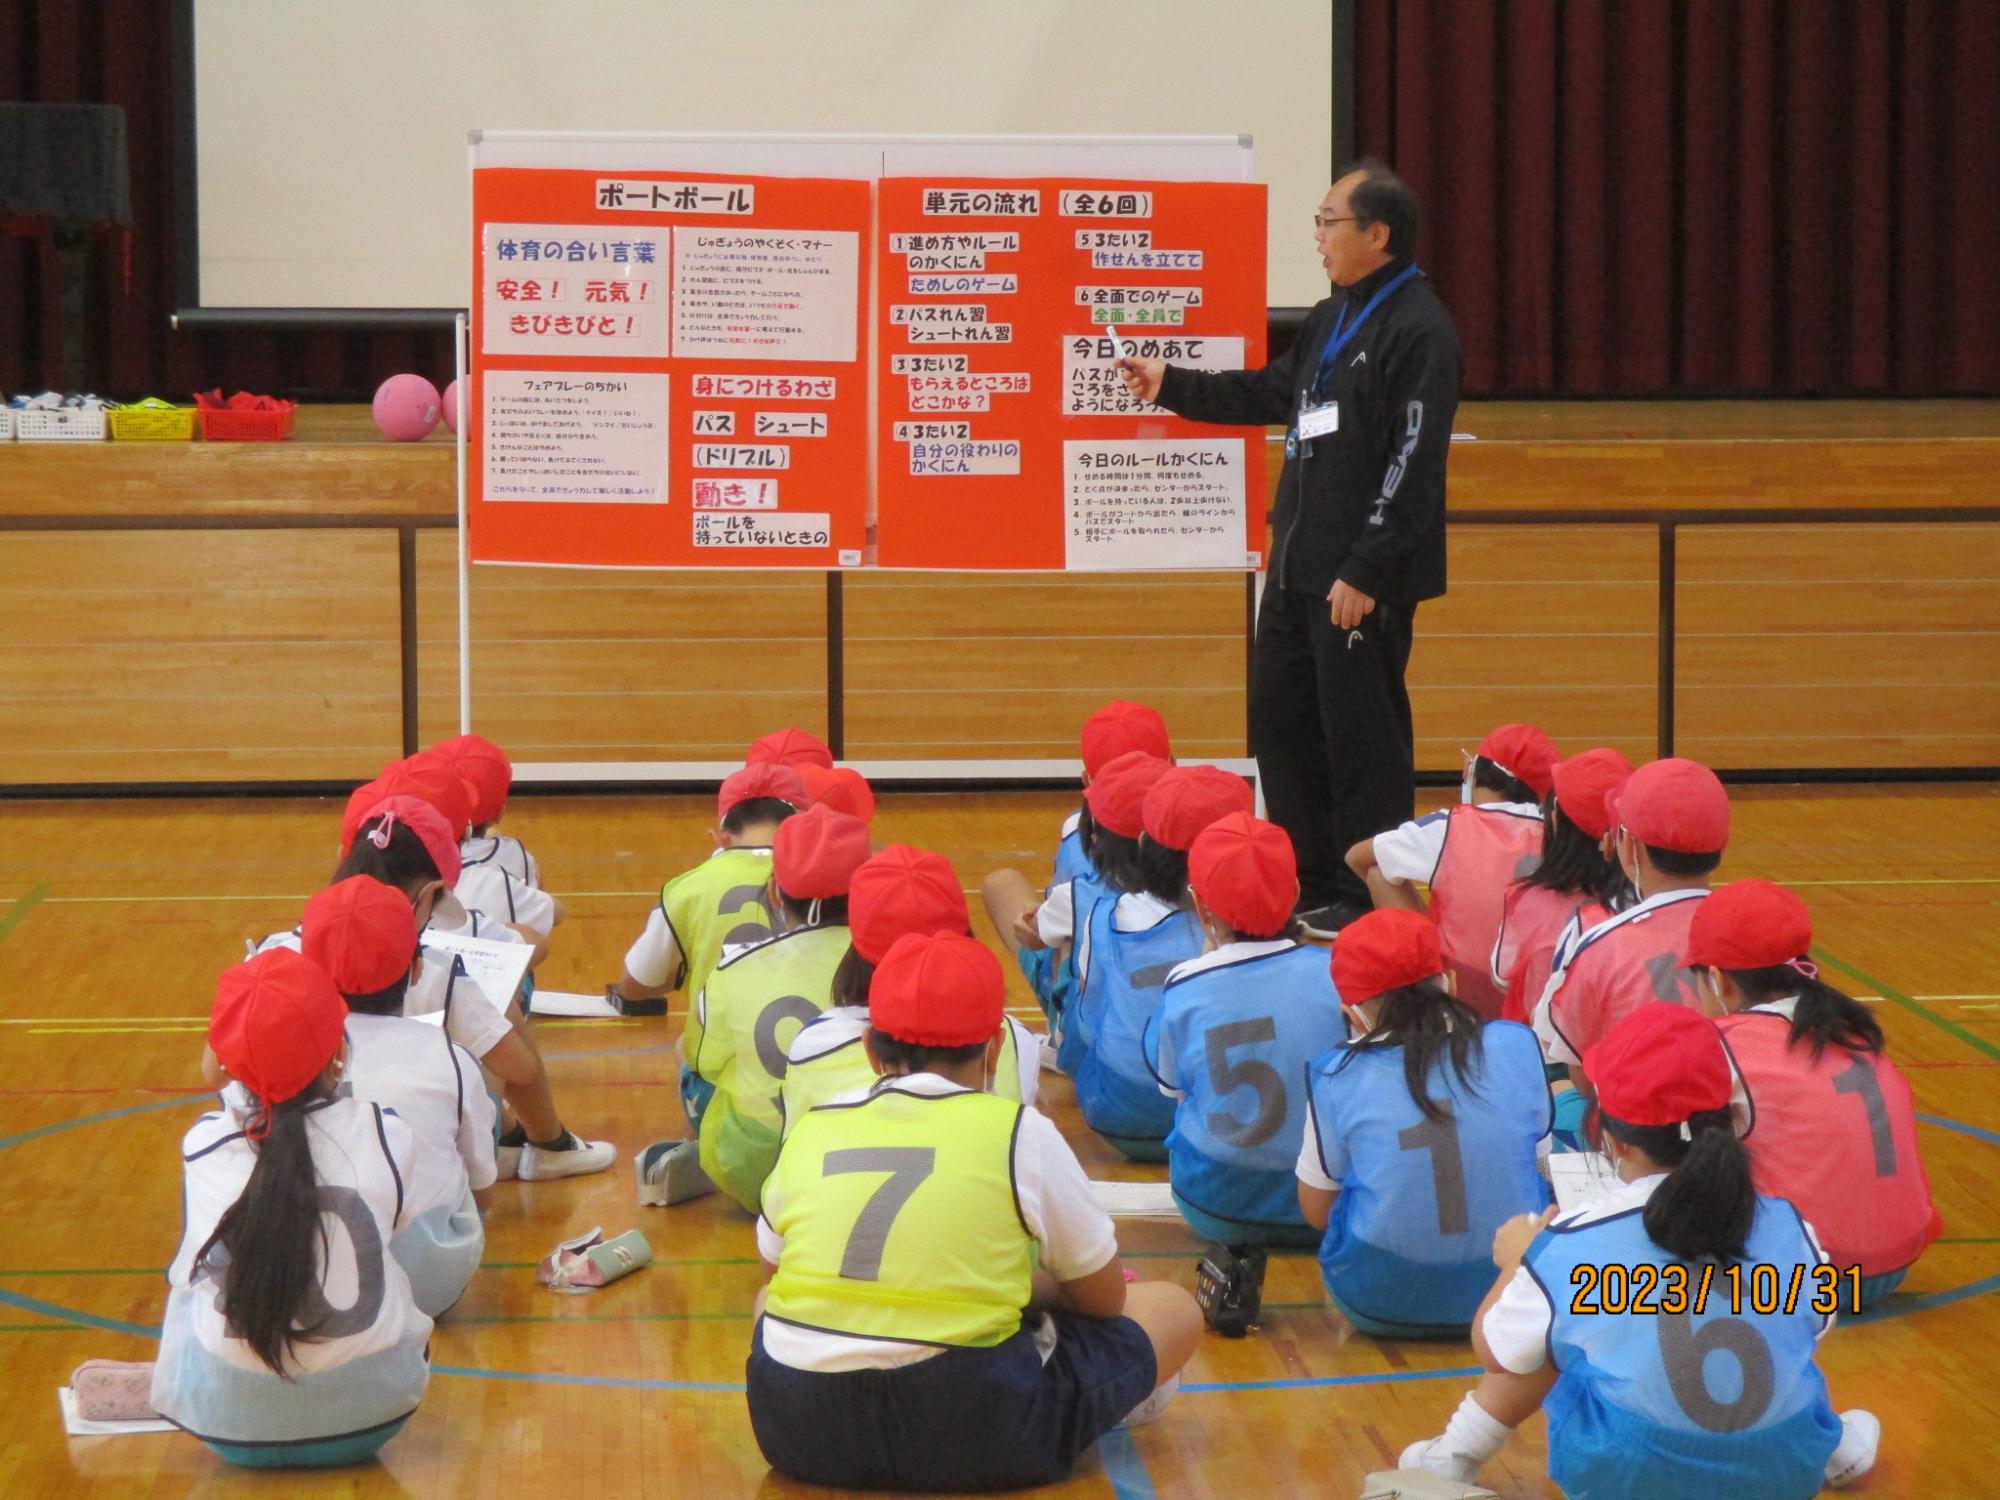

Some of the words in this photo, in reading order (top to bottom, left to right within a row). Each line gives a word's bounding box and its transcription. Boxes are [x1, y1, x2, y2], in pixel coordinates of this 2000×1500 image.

[599, 182, 750, 213] ポートボール
[925, 192, 1038, 214] 単元の流れ
[496, 240, 657, 264] 体育の合い言葉
[697, 237, 834, 250] じゅぎょうのやくそく・マナー
[909, 255, 983, 270] のかくにん
[1094, 253, 1201, 267] 作せんを立てて
[496, 280, 560, 302] 安全！
[585, 280, 649, 303] 元気！
[911, 277, 1015, 292] ためしのゲーム
[1094, 308, 1182, 323] 全面・全員で
[510, 314, 636, 336] きびきびと！
[910, 325, 1010, 341] シュートれん習
[1073, 337, 1204, 359] 今日のめあて
[524, 380, 628, 392] フェアプレーのちかい
[695, 375, 833, 398] 身につけるわざ
[910, 376, 1029, 391] もらえるところは
[911, 395, 985, 410] どこかな？
[695, 414, 732, 433] パス
[757, 416, 825, 434] シュート
[696, 446, 787, 467] （ドリブル）
[913, 443, 1018, 459] 自分の役わりの
[1078, 451, 1229, 468] 今日のルールかくにん
[912, 459, 970, 473] かくにん
[695, 481, 768, 507] 動き！
[695, 515, 756, 529] ボールを
[695, 530, 828, 546] 持っていないときの
[1204, 1015, 1288, 1149] 5
[1831, 1053, 1898, 1178] 1
[1397, 1097, 1470, 1236] 1
[821, 1146, 937, 1282] 7
